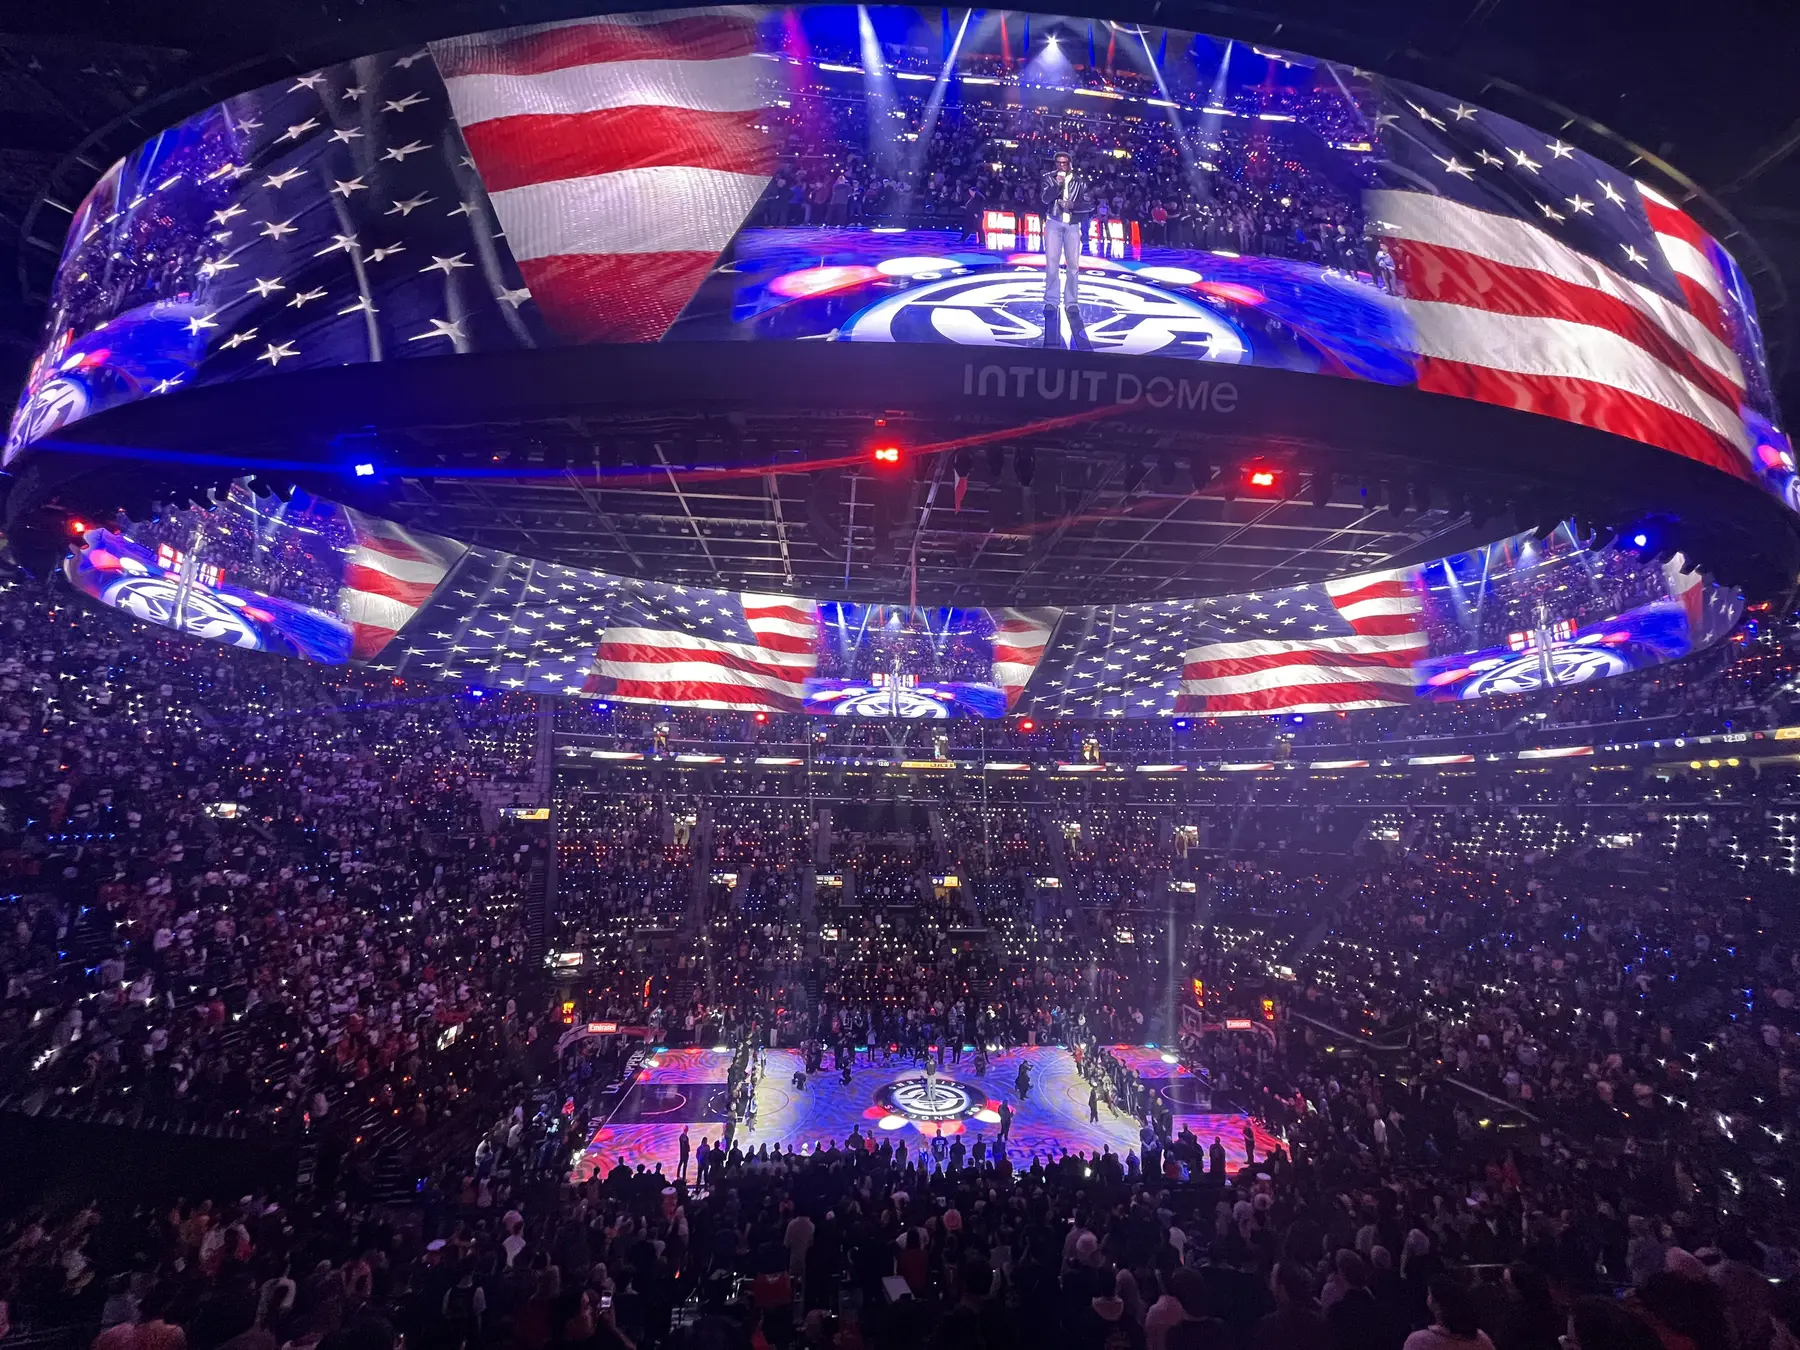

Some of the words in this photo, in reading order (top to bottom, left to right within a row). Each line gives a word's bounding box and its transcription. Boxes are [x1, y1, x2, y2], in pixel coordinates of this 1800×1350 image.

[963, 363, 1107, 402] INTUIT
[1722, 733, 1747, 743] 12:00
[589, 1023, 616, 1032] Emirates
